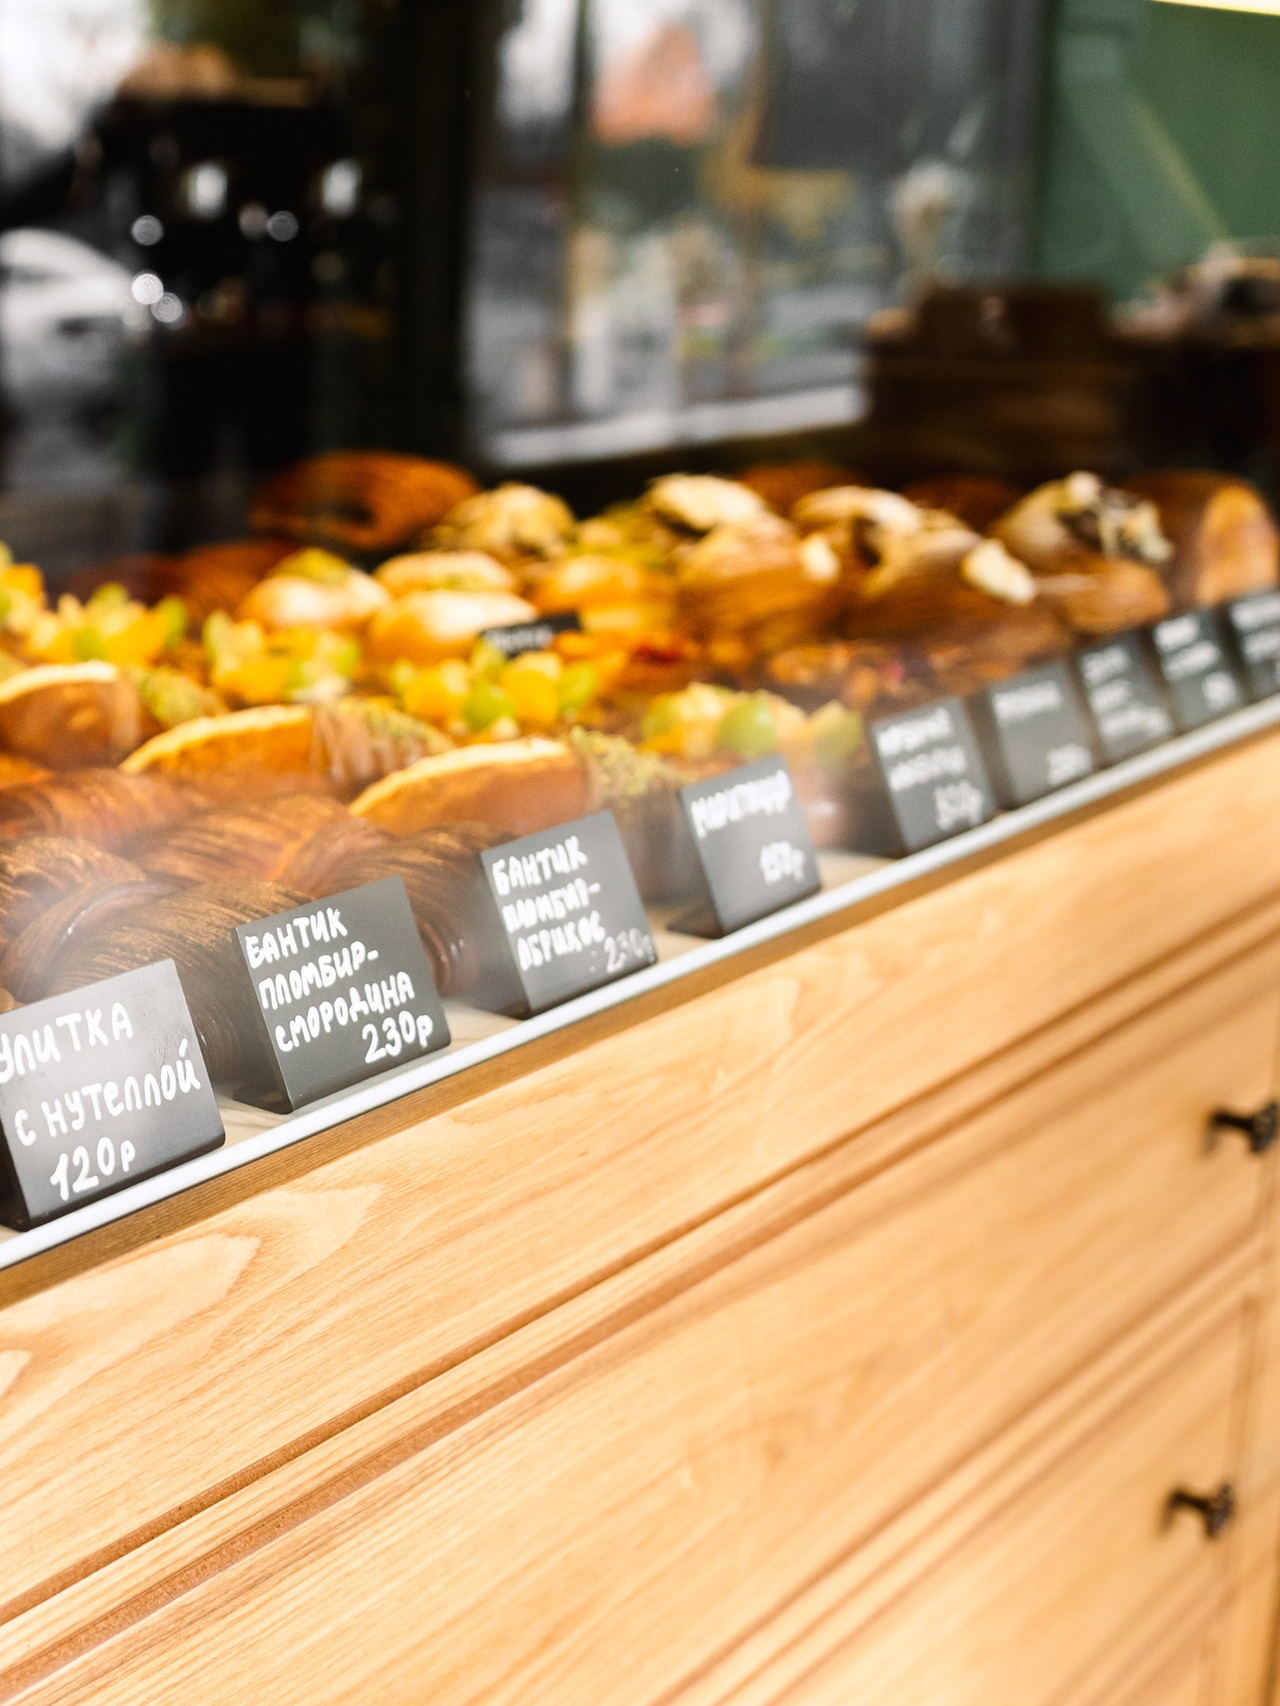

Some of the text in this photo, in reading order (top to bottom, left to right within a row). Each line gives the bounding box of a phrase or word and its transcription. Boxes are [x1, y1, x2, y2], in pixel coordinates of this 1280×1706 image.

[492, 835, 588, 896] БАНТИК
[245, 907, 348, 969] БАНТИК
[275, 971, 415, 1052] СМОРОДИНА
